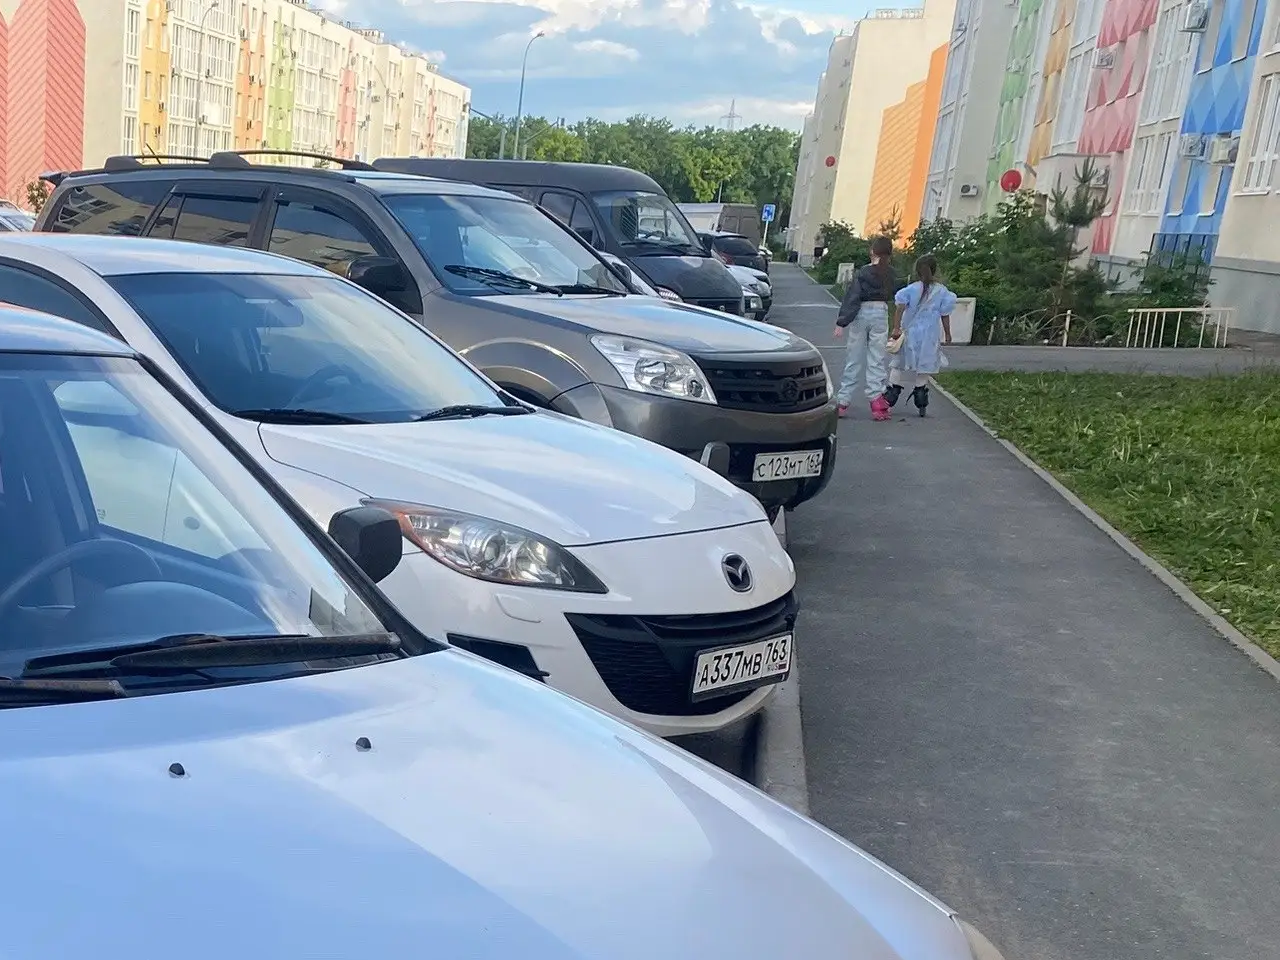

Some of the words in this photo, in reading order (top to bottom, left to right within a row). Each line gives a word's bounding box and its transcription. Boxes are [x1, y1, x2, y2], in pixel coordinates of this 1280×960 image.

[758, 457, 803, 477] С123МТ
[699, 651, 762, 687] А337МВ
[765, 640, 787, 664] 763
